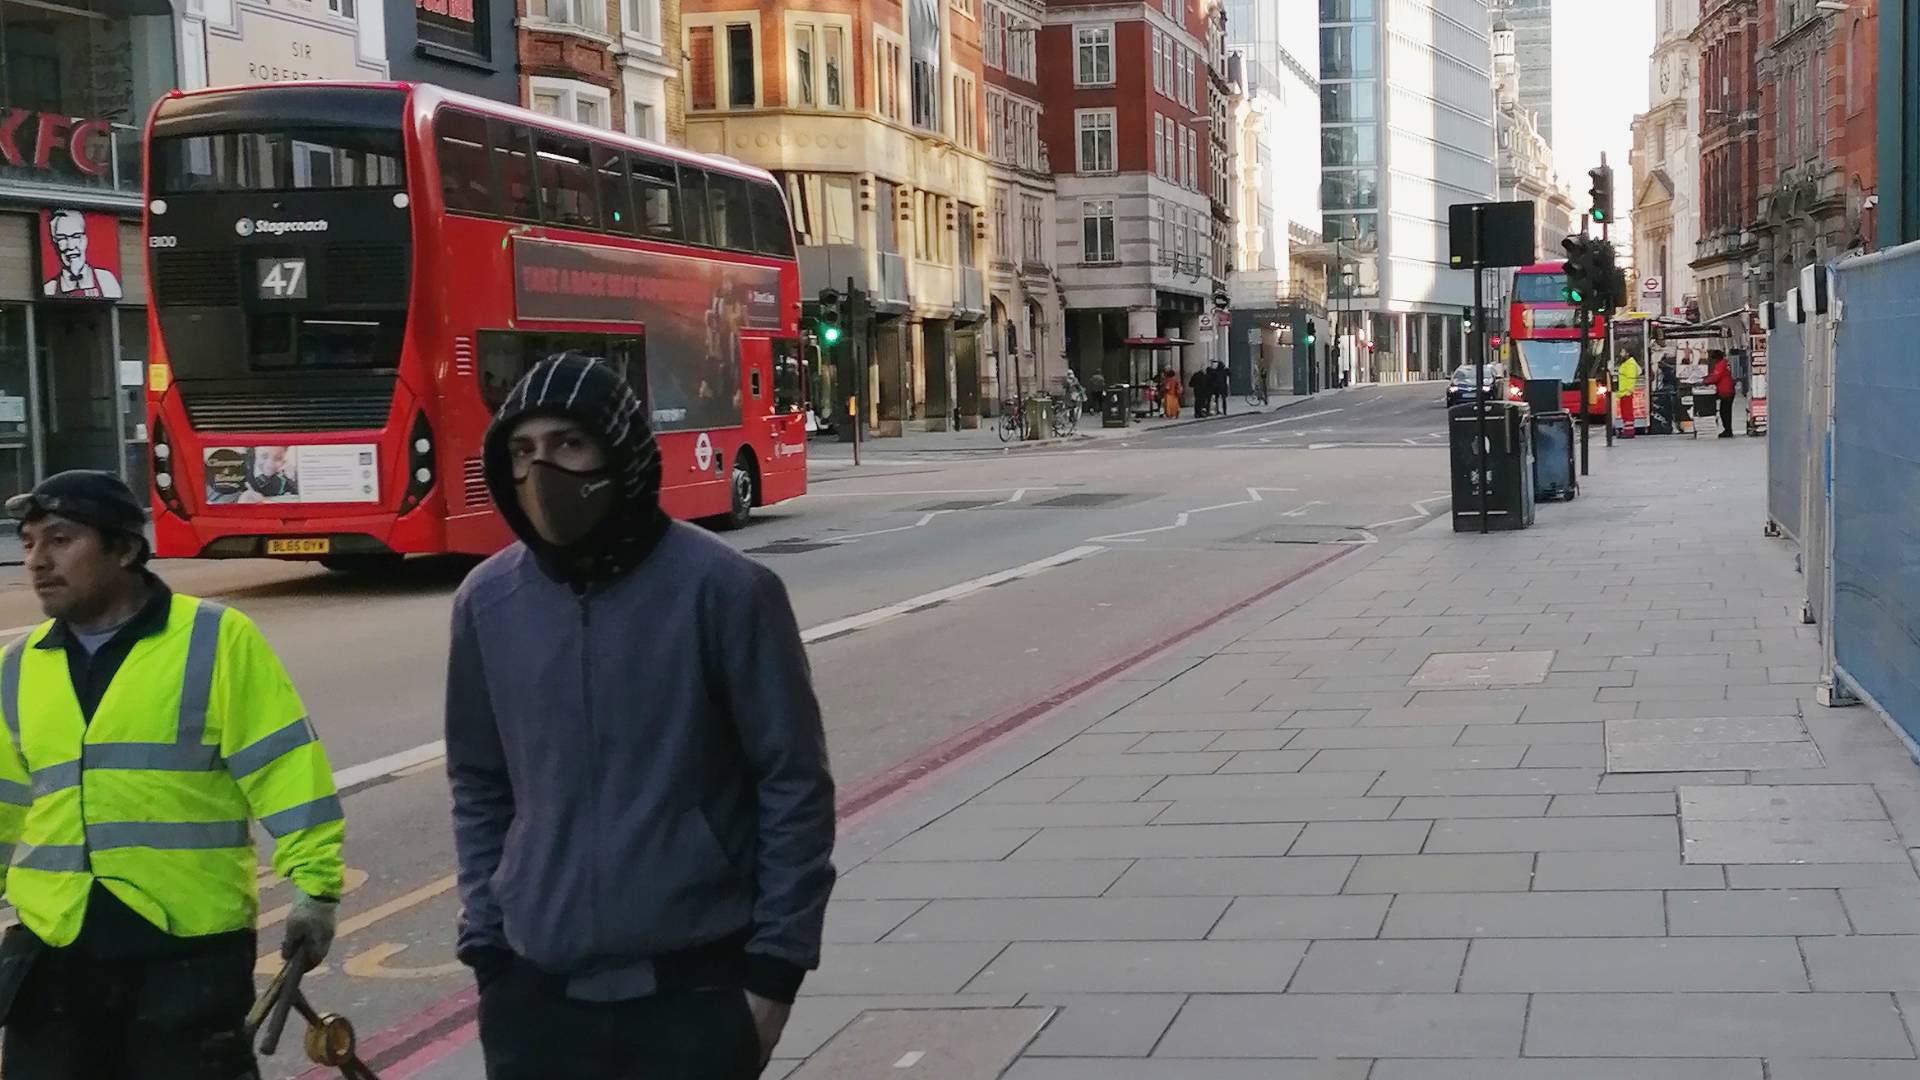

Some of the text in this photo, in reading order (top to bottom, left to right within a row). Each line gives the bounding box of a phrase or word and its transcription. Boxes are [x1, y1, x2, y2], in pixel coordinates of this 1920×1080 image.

[292, 41, 312, 60] SIR
[0, 107, 111, 175] KFC
[255, 220, 328, 235] Stagecoach
[261, 261, 305, 296] 47
